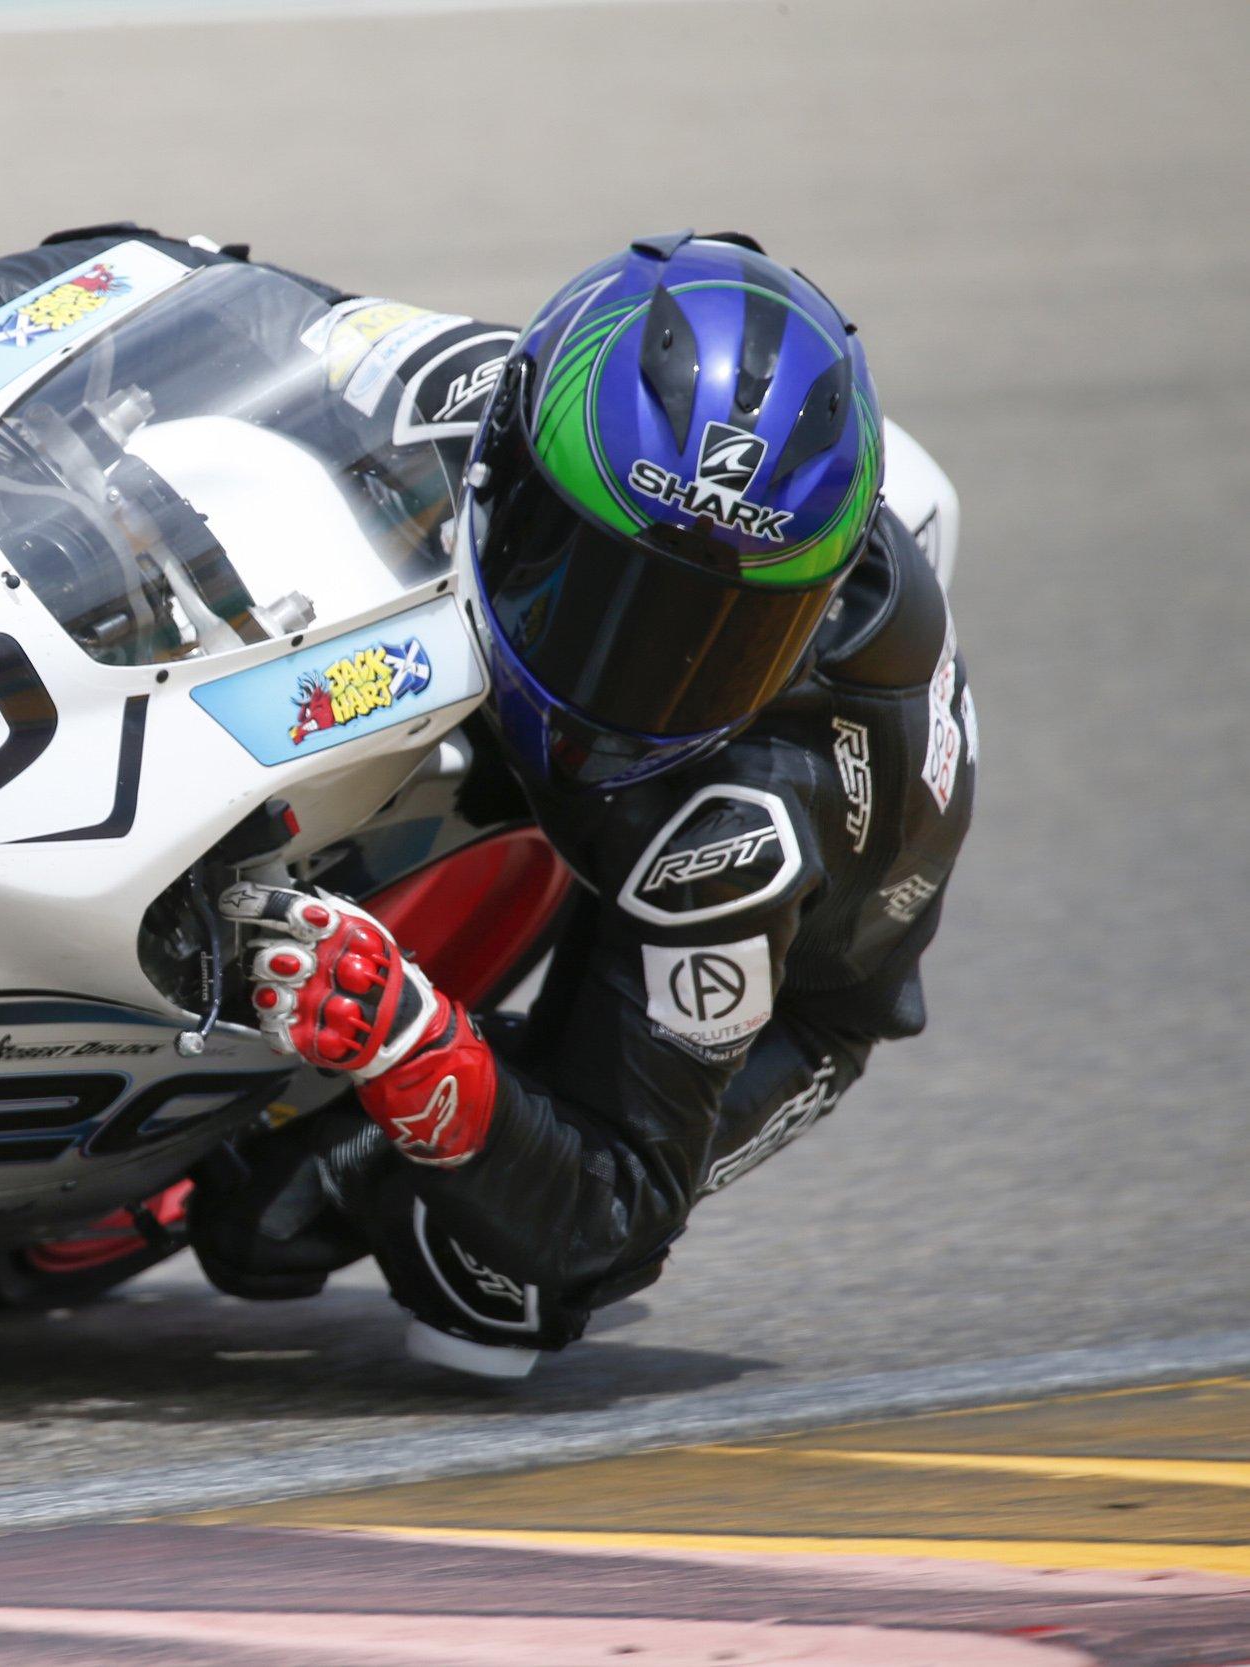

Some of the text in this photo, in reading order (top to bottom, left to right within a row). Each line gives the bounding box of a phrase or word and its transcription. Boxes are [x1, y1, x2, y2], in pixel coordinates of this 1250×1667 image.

[628, 458, 795, 543] SHARK
[324, 646, 394, 698] JACK
[330, 682, 392, 724] HART
[832, 716, 874, 853] RST
[642, 825, 780, 893] RST
